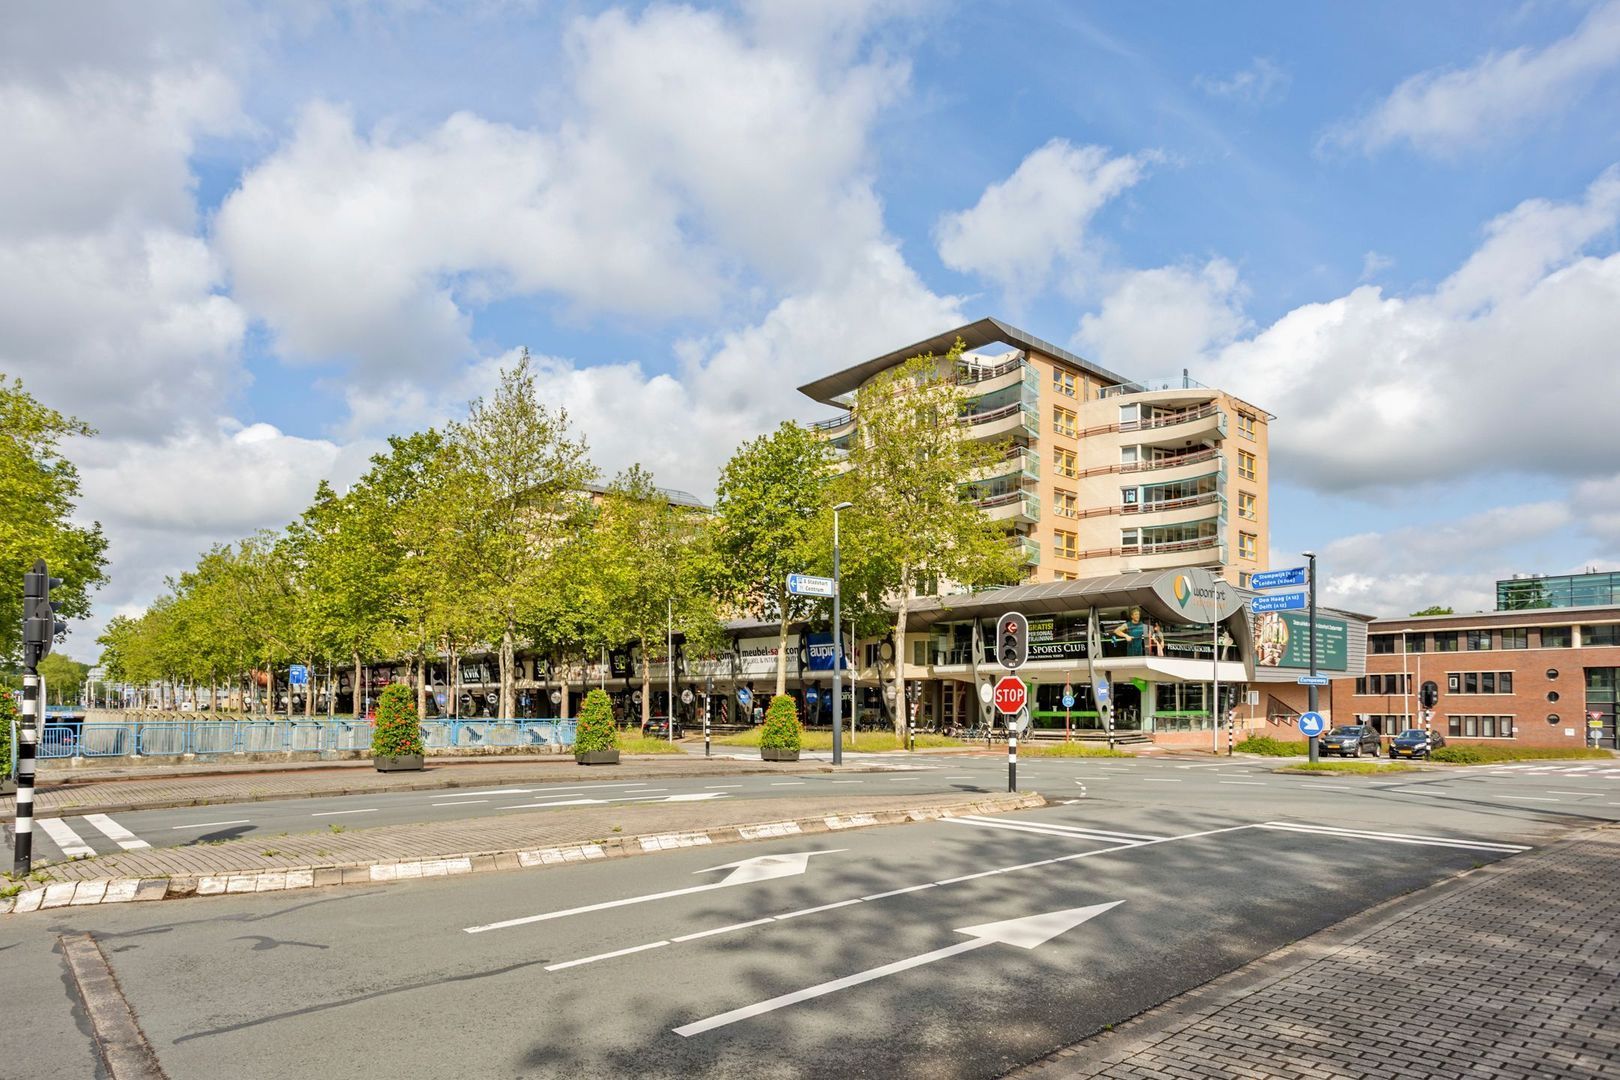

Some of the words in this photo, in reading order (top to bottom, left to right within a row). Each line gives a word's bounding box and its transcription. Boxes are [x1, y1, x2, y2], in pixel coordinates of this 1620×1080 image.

[805, 585, 825, 593] Centrum
[1028, 622, 1054, 631] GRATIS!
[1063, 643, 1087, 653] CLUB
[996, 688, 1024, 703] STOP
